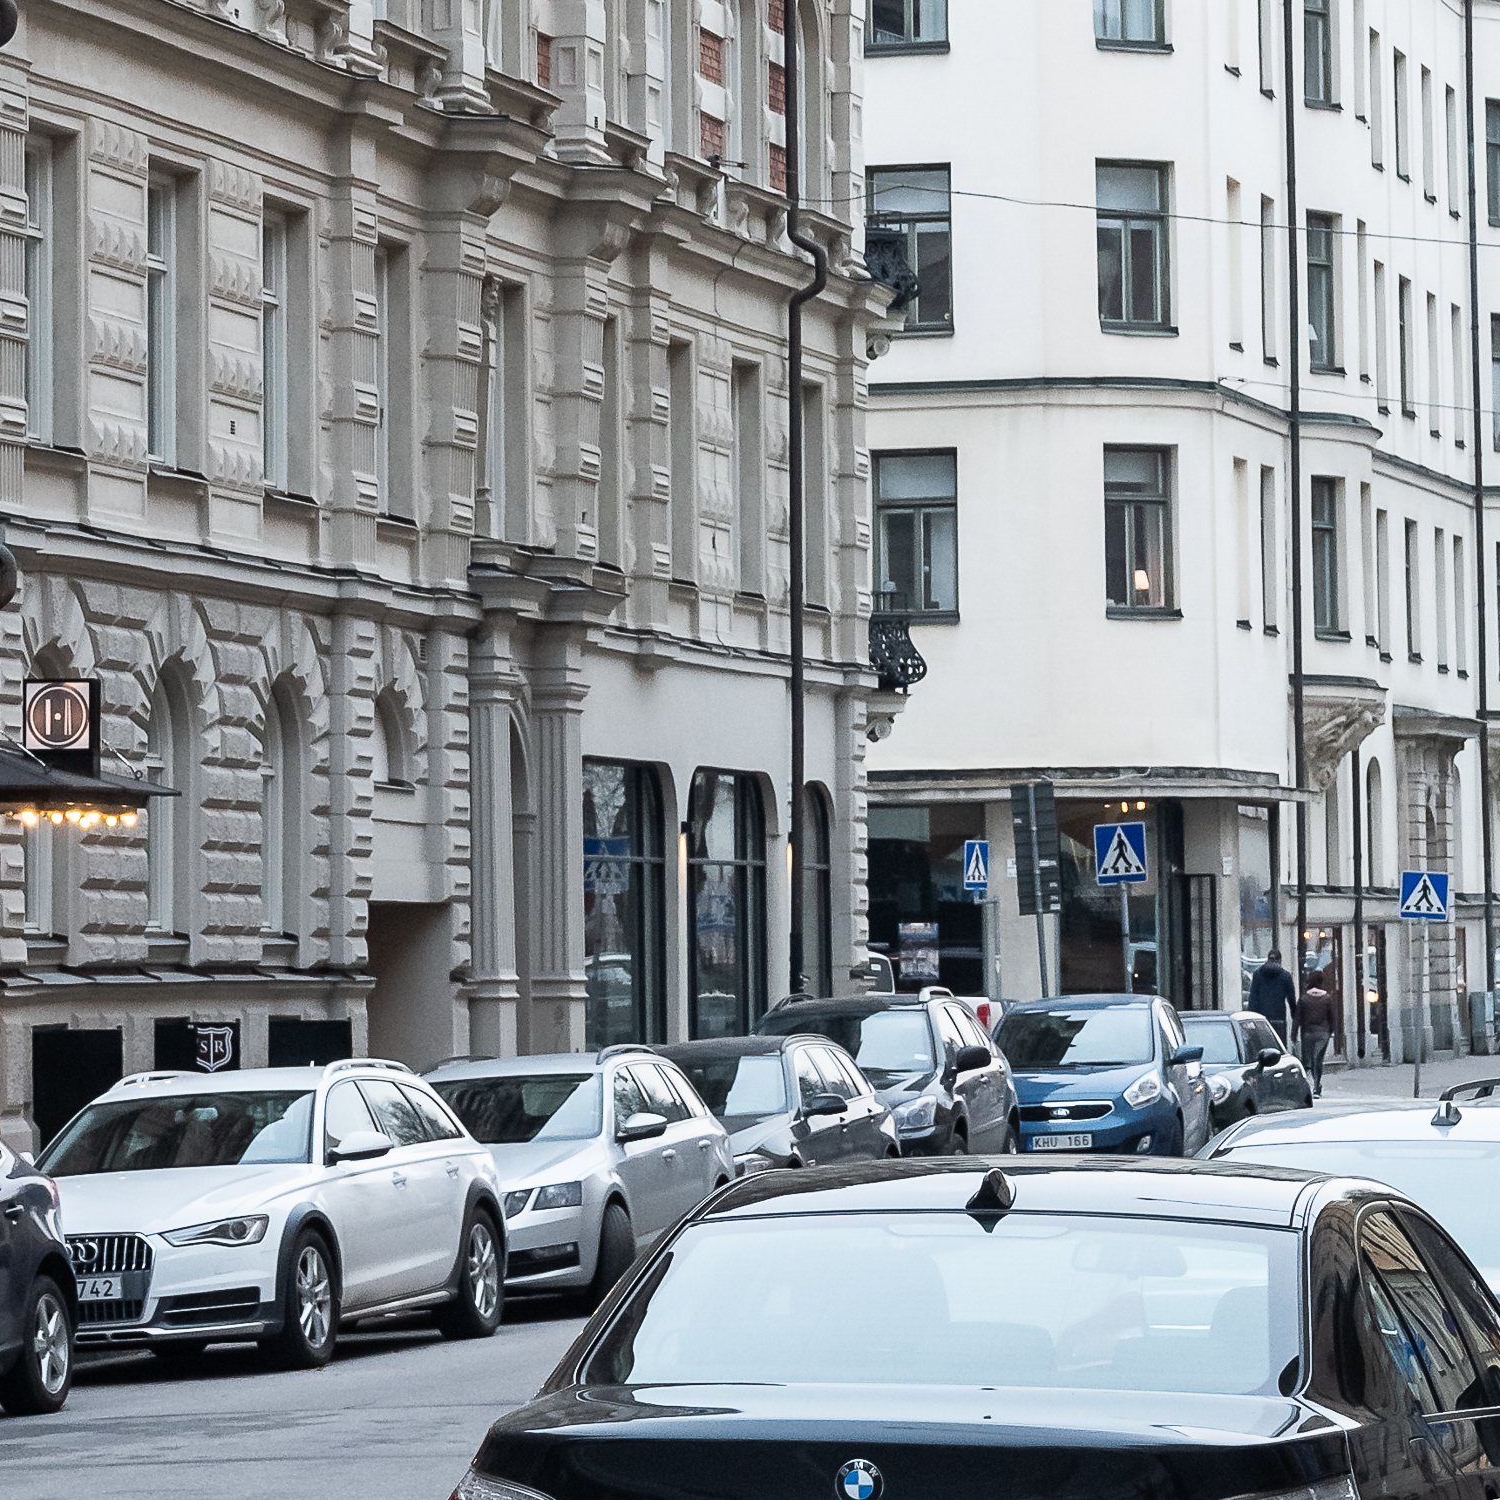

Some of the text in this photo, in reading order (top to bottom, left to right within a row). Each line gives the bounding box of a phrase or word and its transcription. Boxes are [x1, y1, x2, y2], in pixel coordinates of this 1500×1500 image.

[1034, 1135, 1089, 1148] KHU 166
[77, 1279, 113, 1298] 742
[840, 1460, 879, 1478] BMW
